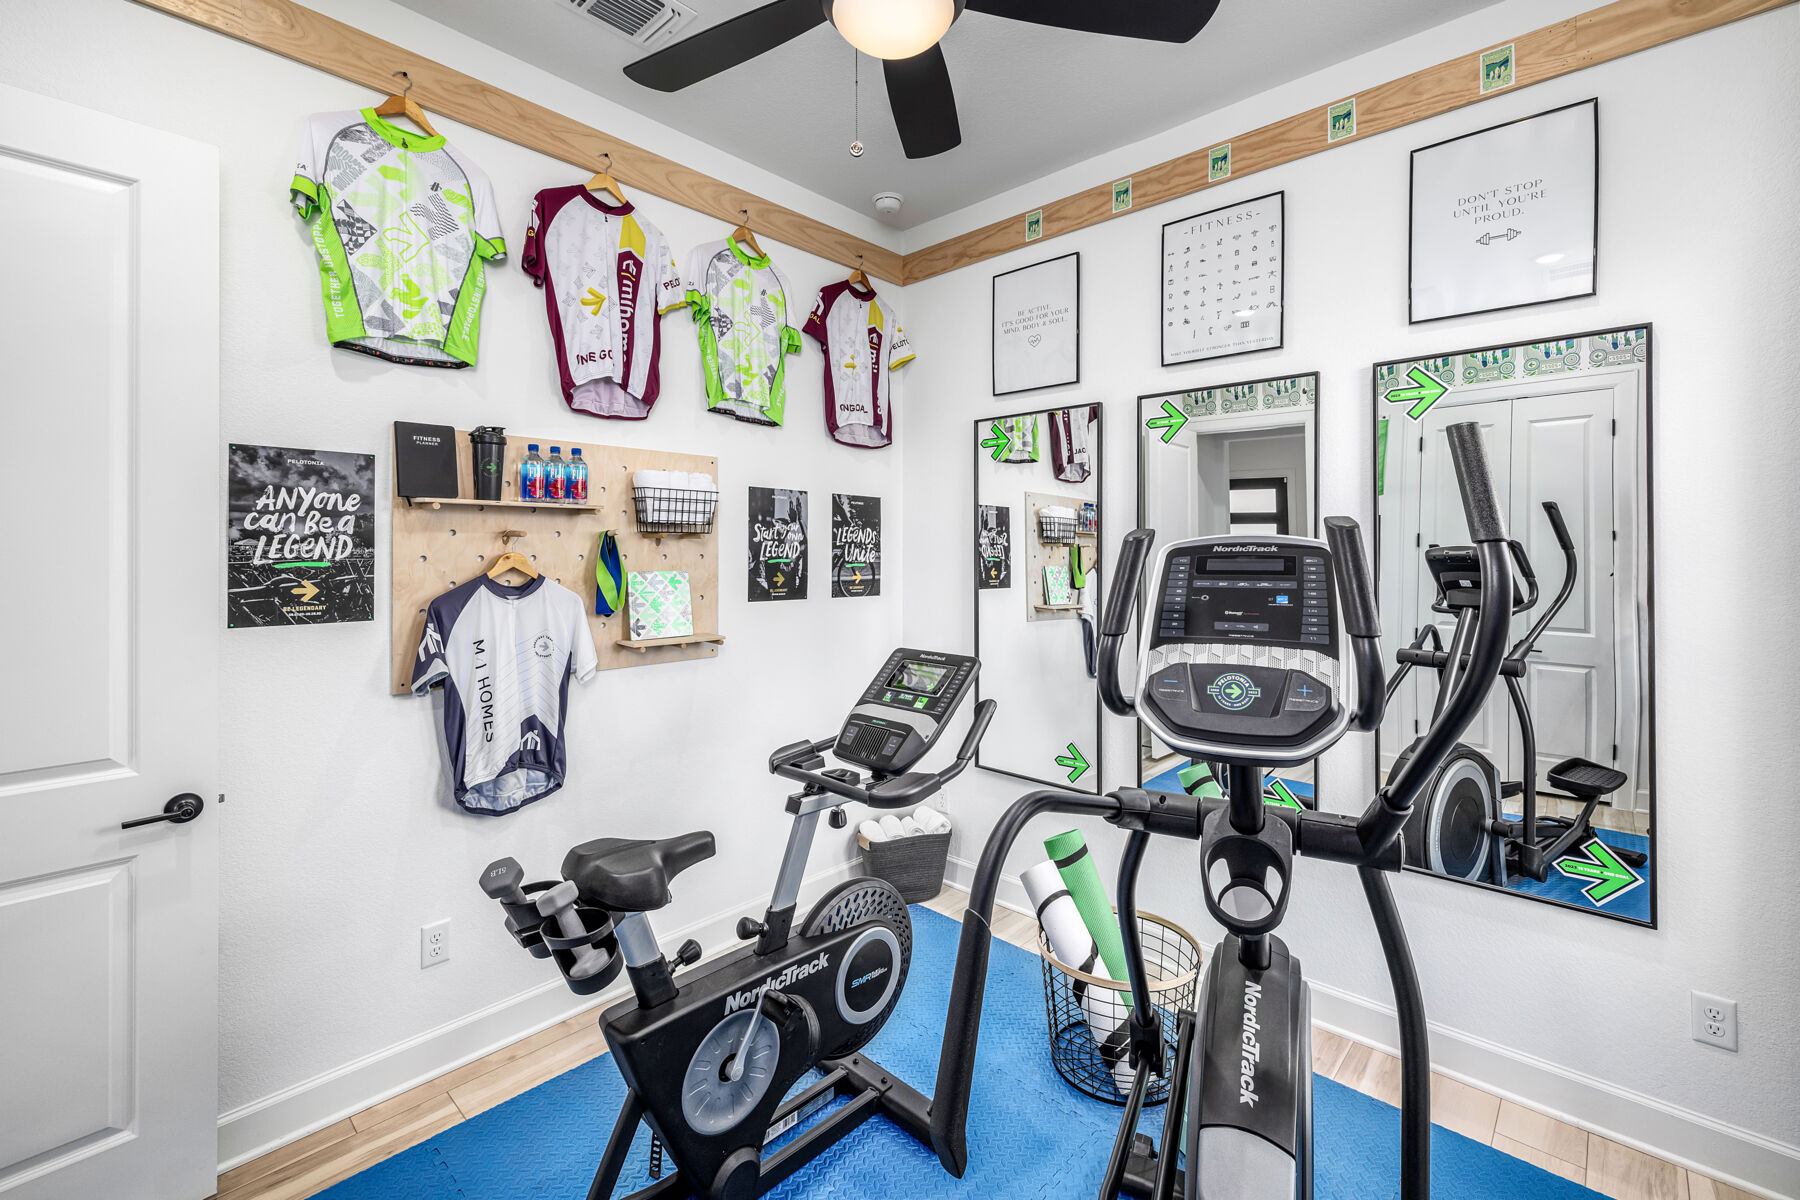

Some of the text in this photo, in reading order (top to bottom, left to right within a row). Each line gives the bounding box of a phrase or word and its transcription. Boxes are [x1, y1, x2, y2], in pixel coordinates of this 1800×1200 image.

[1453, 188, 1546, 219] UNTIL YOU'RE
[1458, 178, 1543, 206] DON'T STOP
[1474, 207, 1525, 224] PROUD.
[1217, 675, 1250, 687] PELOTONIA
[477, 676, 494, 743] HOMES
[723, 951, 830, 1017] NordicTrack
[1239, 980, 1262, 1108] NordicTrack
